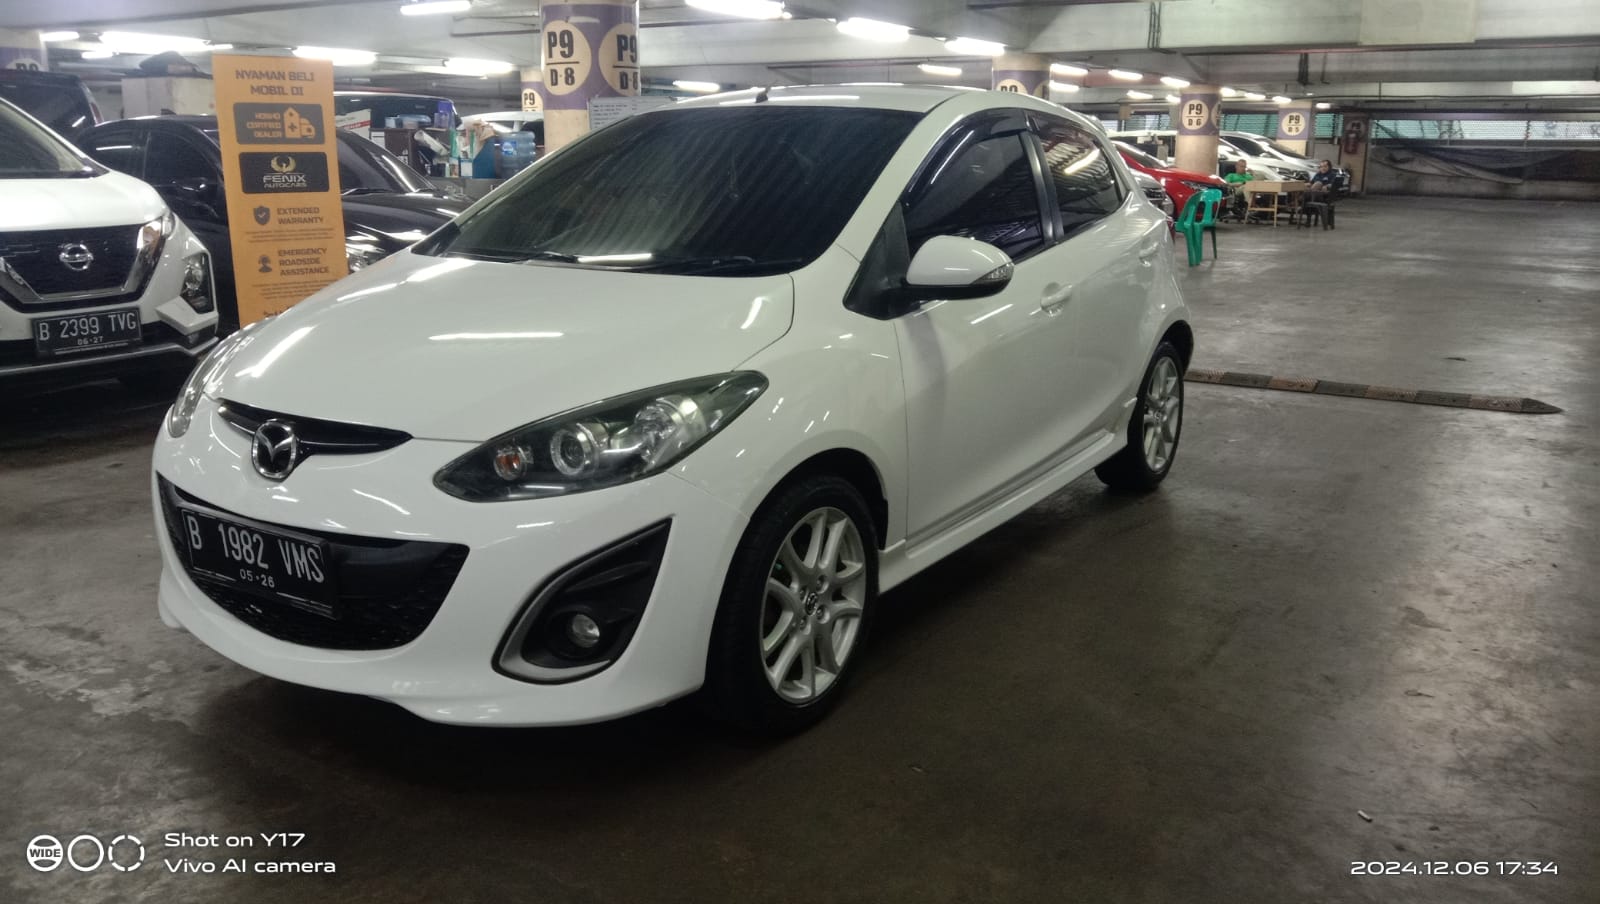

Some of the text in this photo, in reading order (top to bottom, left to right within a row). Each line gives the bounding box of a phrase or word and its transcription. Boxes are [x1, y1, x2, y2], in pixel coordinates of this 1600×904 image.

[547, 29, 575, 59] P9
[616, 34, 638, 63] P9
[235, 69, 315, 81] NYAMAN BELI
[250, 85, 304, 96] MOBIL DI
[523, 92, 536, 106] P9
[1188, 103, 1203, 115] P9
[1288, 114, 1301, 124] P9
[262, 174, 307, 183] FENIX
[277, 207, 320, 215] EXTENDED
[278, 217, 324, 225] WARRANTY
[278, 248, 328, 257] EMERGENCY
[279, 258, 321, 266] ROADSIDE
[280, 267, 329, 276] ASSISTANCE
[39, 312, 136, 341] B 2399 TVG
[186, 515, 325, 583] B 1982 VMS
